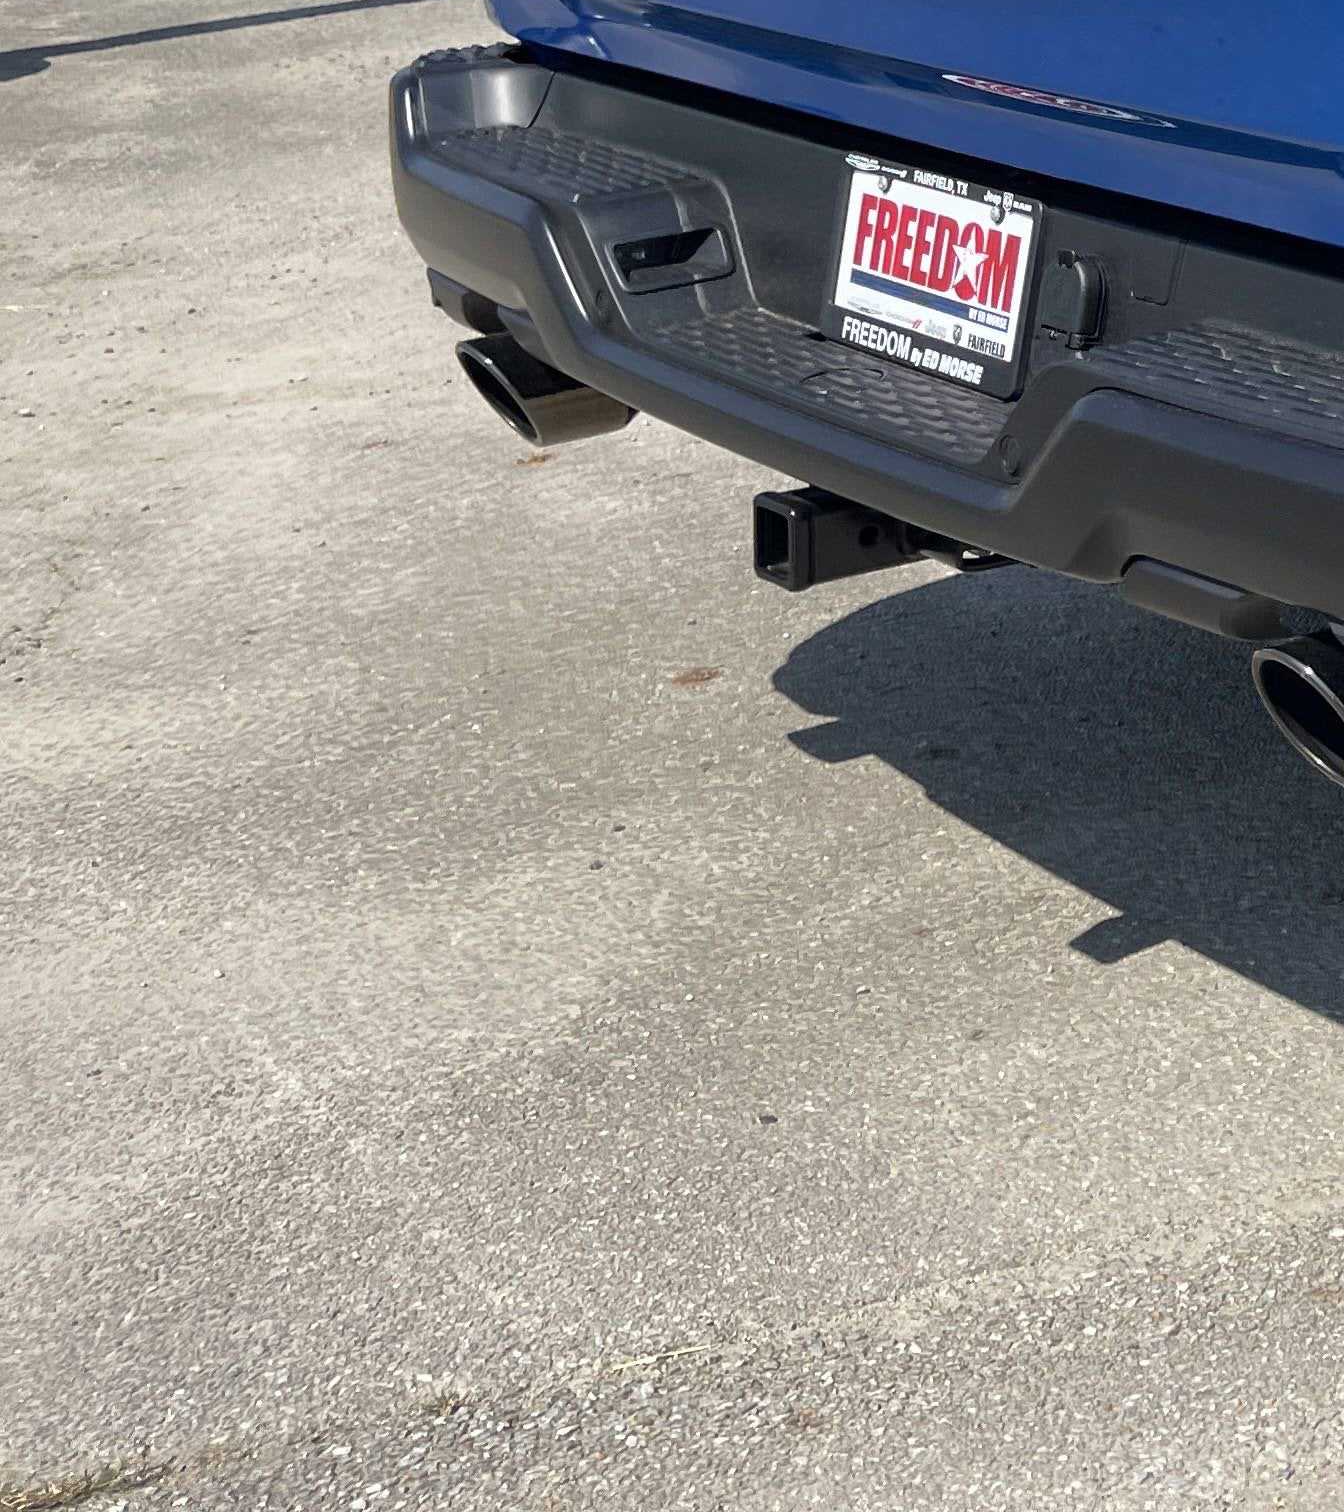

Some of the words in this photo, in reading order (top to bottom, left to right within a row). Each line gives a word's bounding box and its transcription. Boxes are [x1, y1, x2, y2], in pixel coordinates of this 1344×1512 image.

[913, 169, 955, 195] FAIRFIELD,
[957, 180, 969, 196] TX
[852, 192, 1022, 314] FREEDOM
[841, 315, 912, 361] FREEDOM
[910, 347, 924, 367] by
[921, 348, 940, 370] ED
[937, 353, 985, 386] MORSE
[967, 333, 1006, 358] FAIRFIELD
